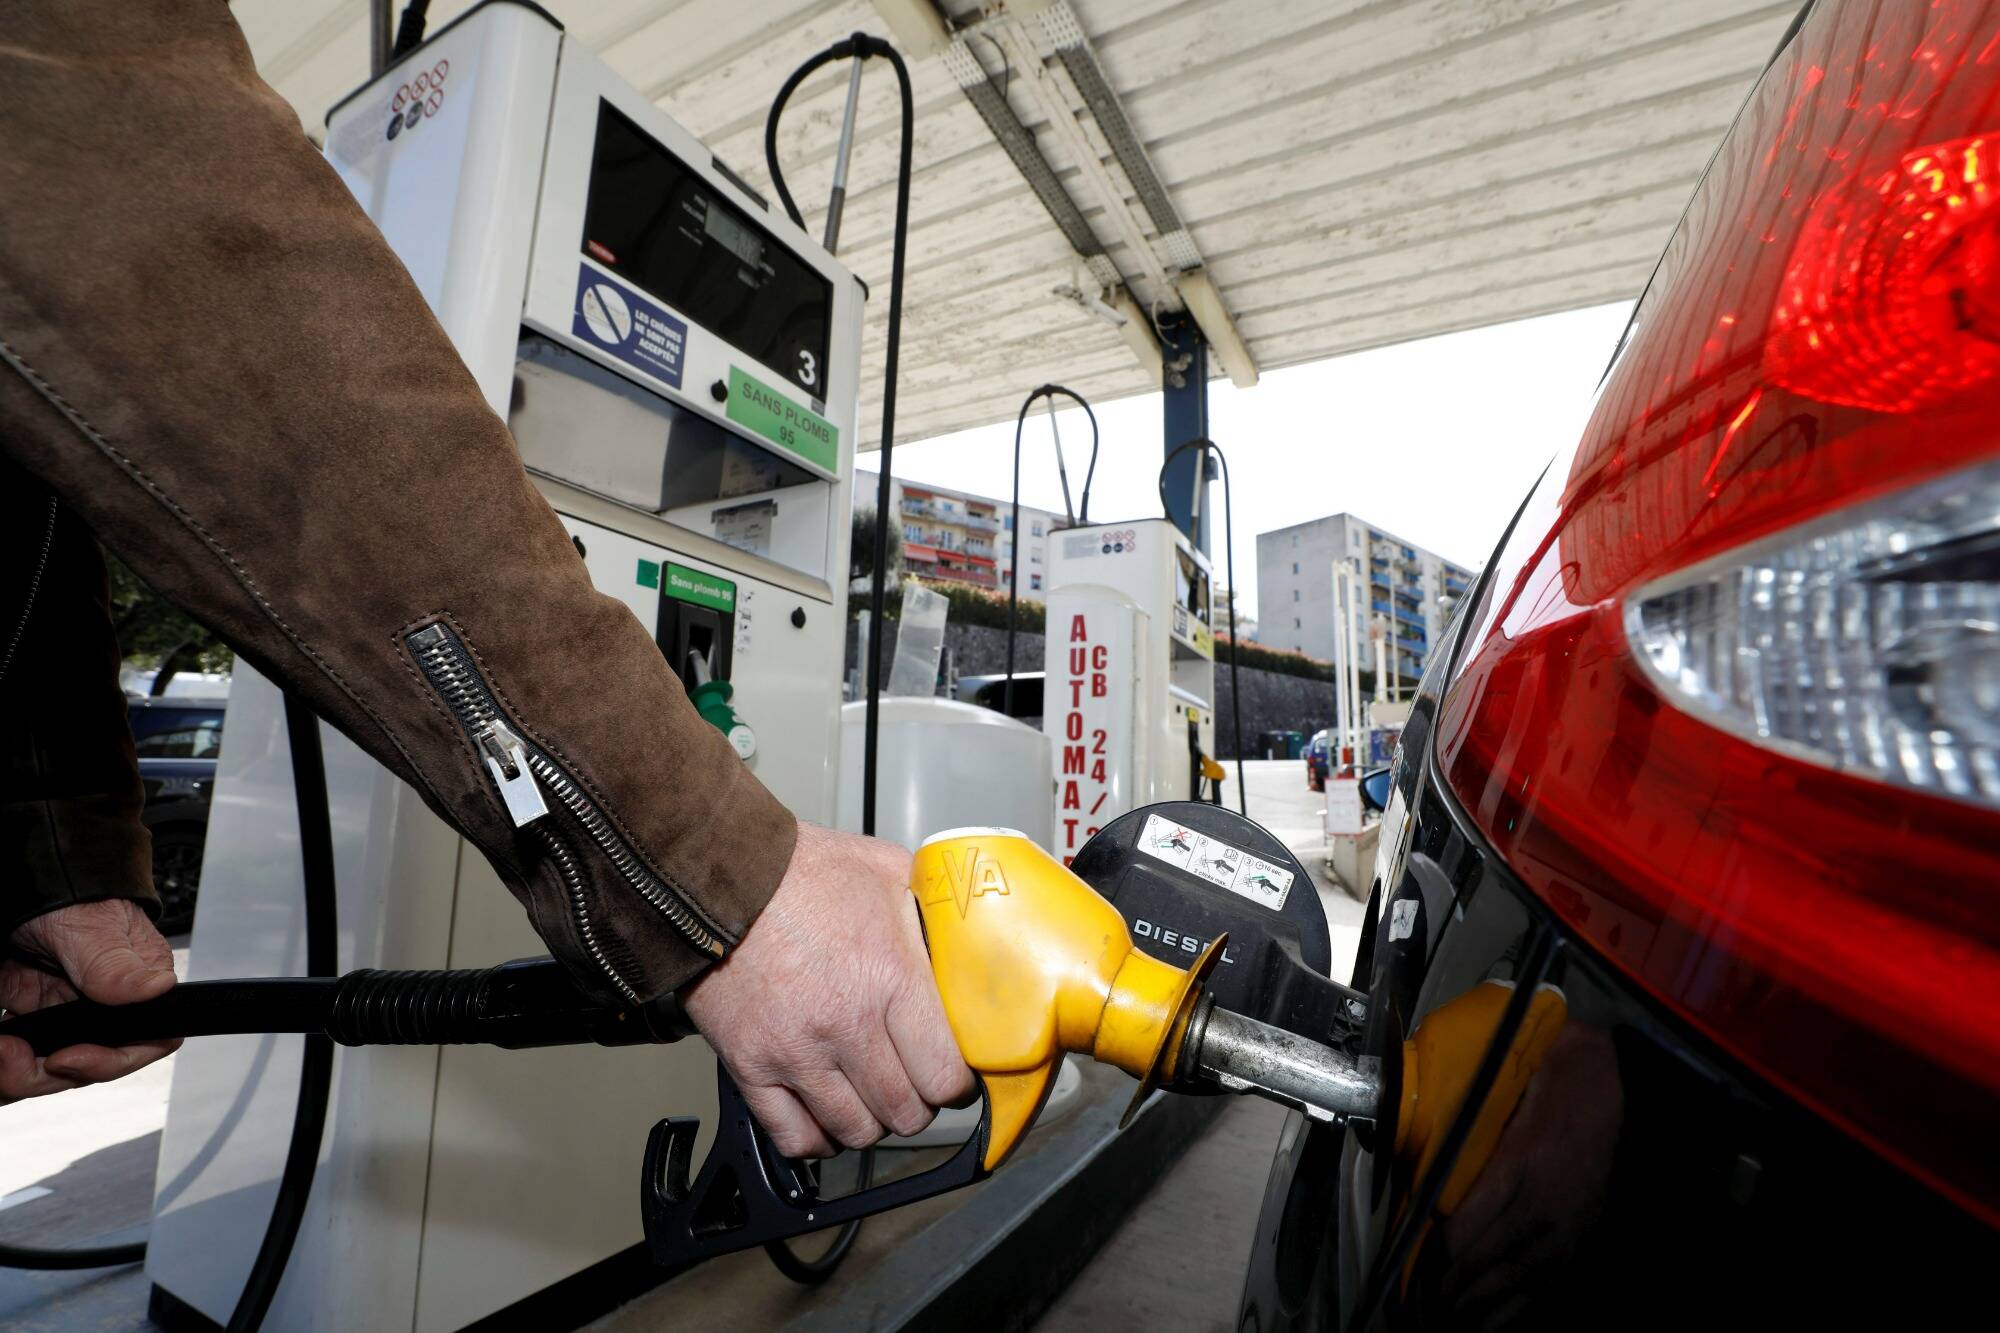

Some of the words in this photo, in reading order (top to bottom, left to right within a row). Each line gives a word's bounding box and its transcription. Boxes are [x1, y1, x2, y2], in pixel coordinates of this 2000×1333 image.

[635, 309, 649, 324] LES
[634, 322, 646, 335] NE
[646, 328, 665, 346] SONT
[665, 340, 680, 354] PAS
[798, 349, 816, 385] 3
[743, 382, 782, 417] SANS
[785, 407, 830, 444] PLOMB
[779, 426, 795, 445] 95
[670, 574, 693, 590] Sans
[693, 583, 721, 598] plomb
[721, 590, 733, 601] 95
[1092, 645, 1107, 697] CB
[1198, 871, 1215, 882] clicks
[1265, 864, 1271, 872] 10
[1134, 919, 1234, 964] DIESL
